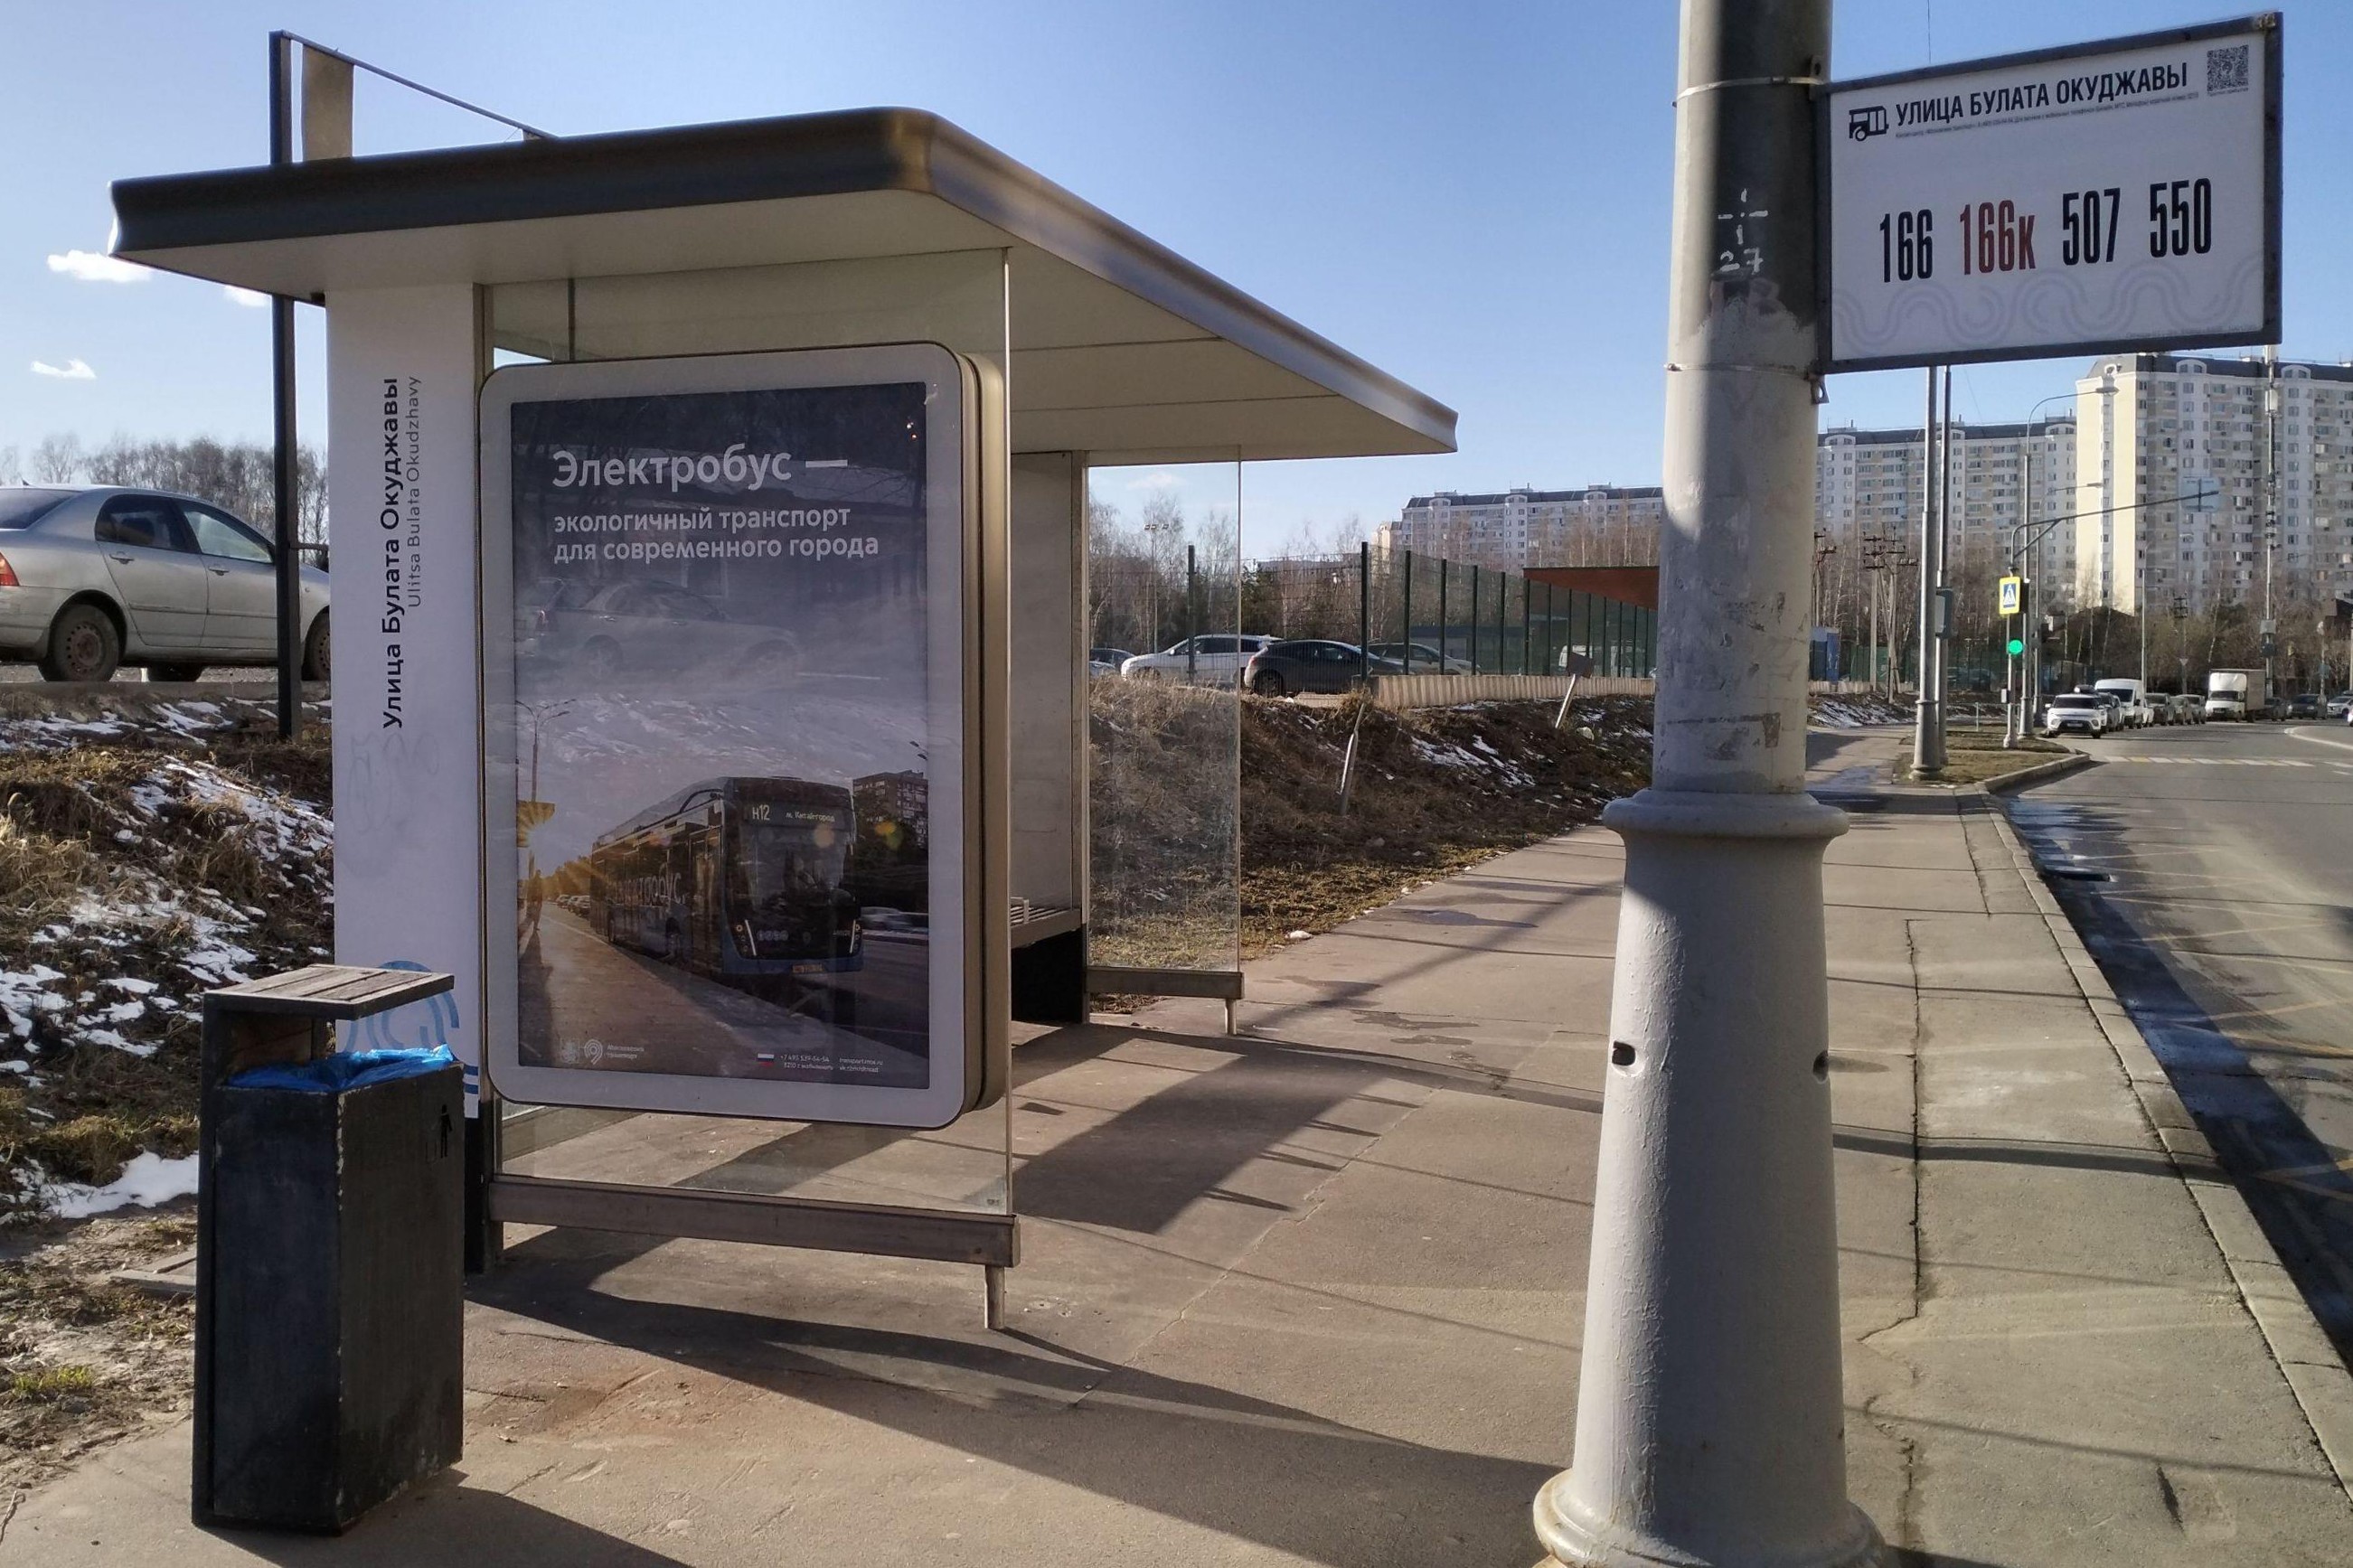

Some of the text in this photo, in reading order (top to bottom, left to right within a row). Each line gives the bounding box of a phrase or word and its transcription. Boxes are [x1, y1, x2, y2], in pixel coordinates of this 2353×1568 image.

[1896, 95, 1963, 126] УЛИЦА
[1970, 83, 2049, 116] БУЛАТА
[2057, 62, 2188, 104] ОКУДЖАВЫ
[1879, 209, 1933, 283] 166
[2062, 187, 2121, 266] 507
[2150, 178, 2212, 258] 550
[405, 376, 421, 608] Ulitsa Bulata Okudzhavy
[552, 443, 792, 492] Электробус
[553, 506, 851, 533] экологичный транспорт
[553, 536, 879, 565] для современного города
[380, 378, 405, 728] Улица Булата Окуджавы
